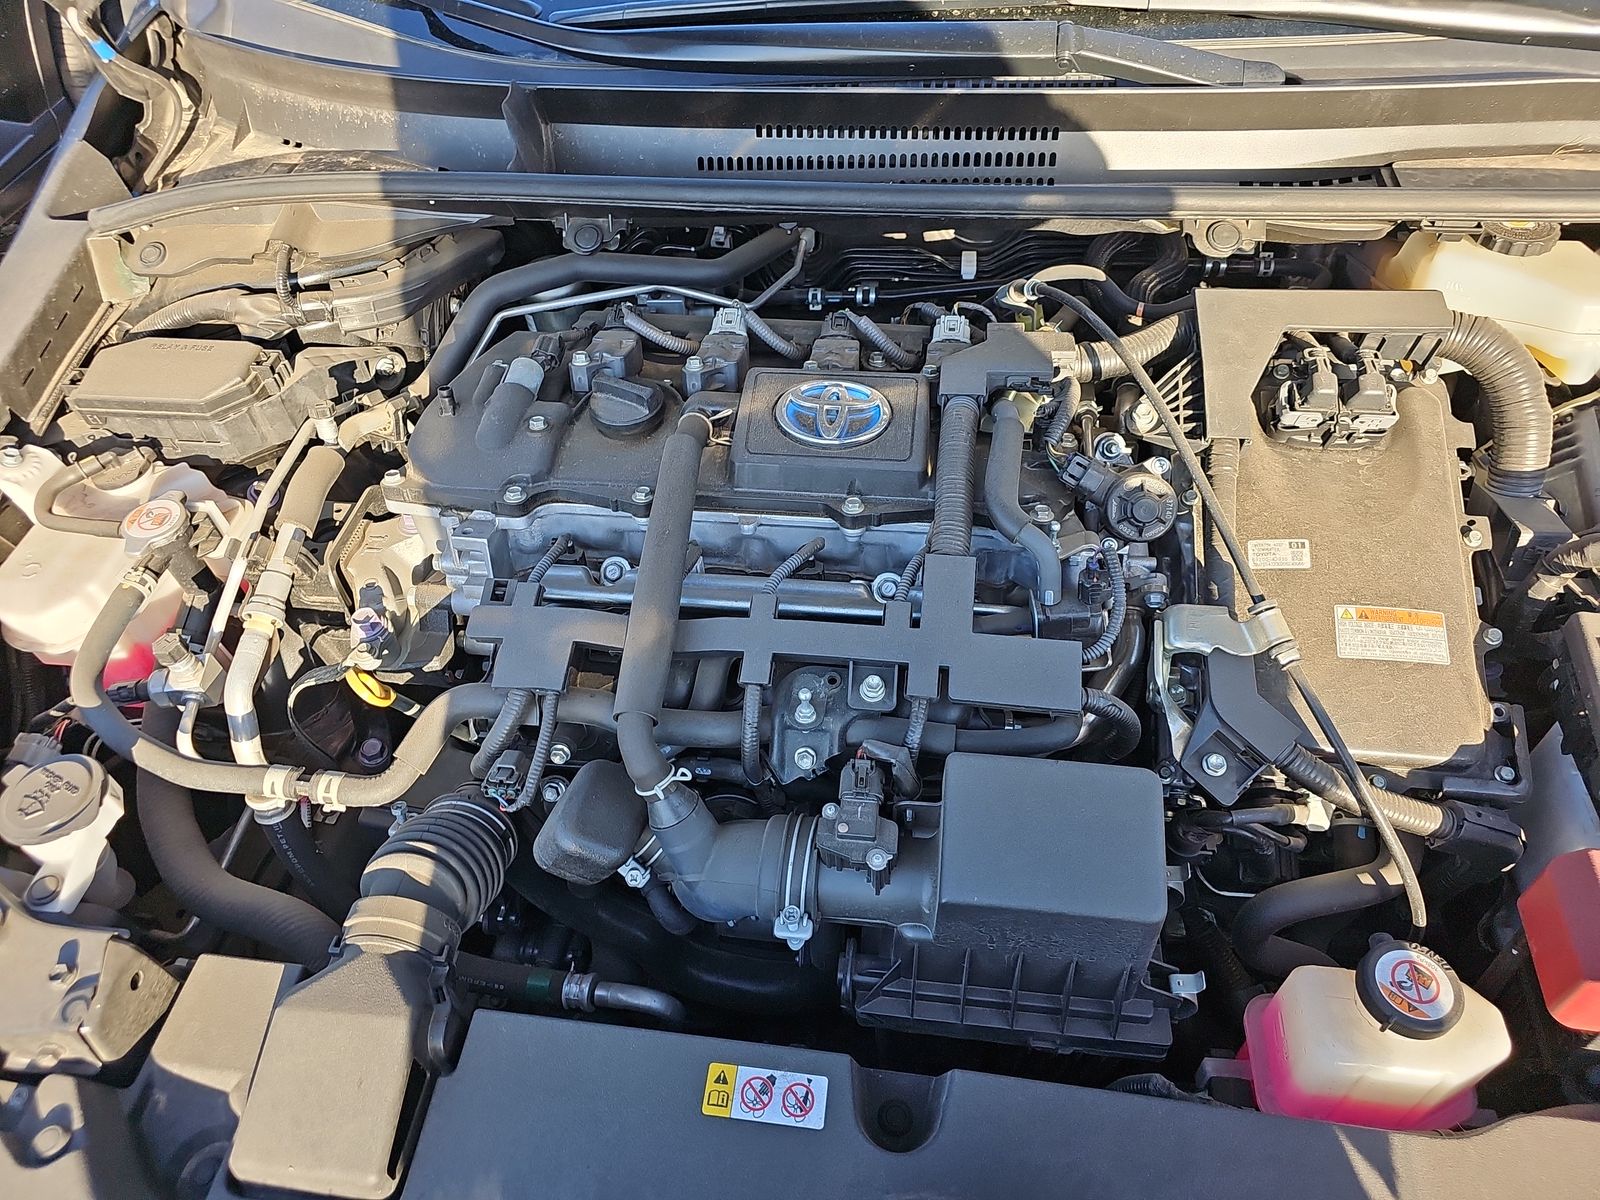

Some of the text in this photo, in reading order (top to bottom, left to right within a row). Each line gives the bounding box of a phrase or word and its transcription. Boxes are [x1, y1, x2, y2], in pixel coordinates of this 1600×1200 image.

[190, 344, 215, 352] FUSE
[1165, 499, 1174, 519] 37140
[1145, 526, 1165, 538] TOYOTA
[1409, 942, 1452, 971] DENSO
